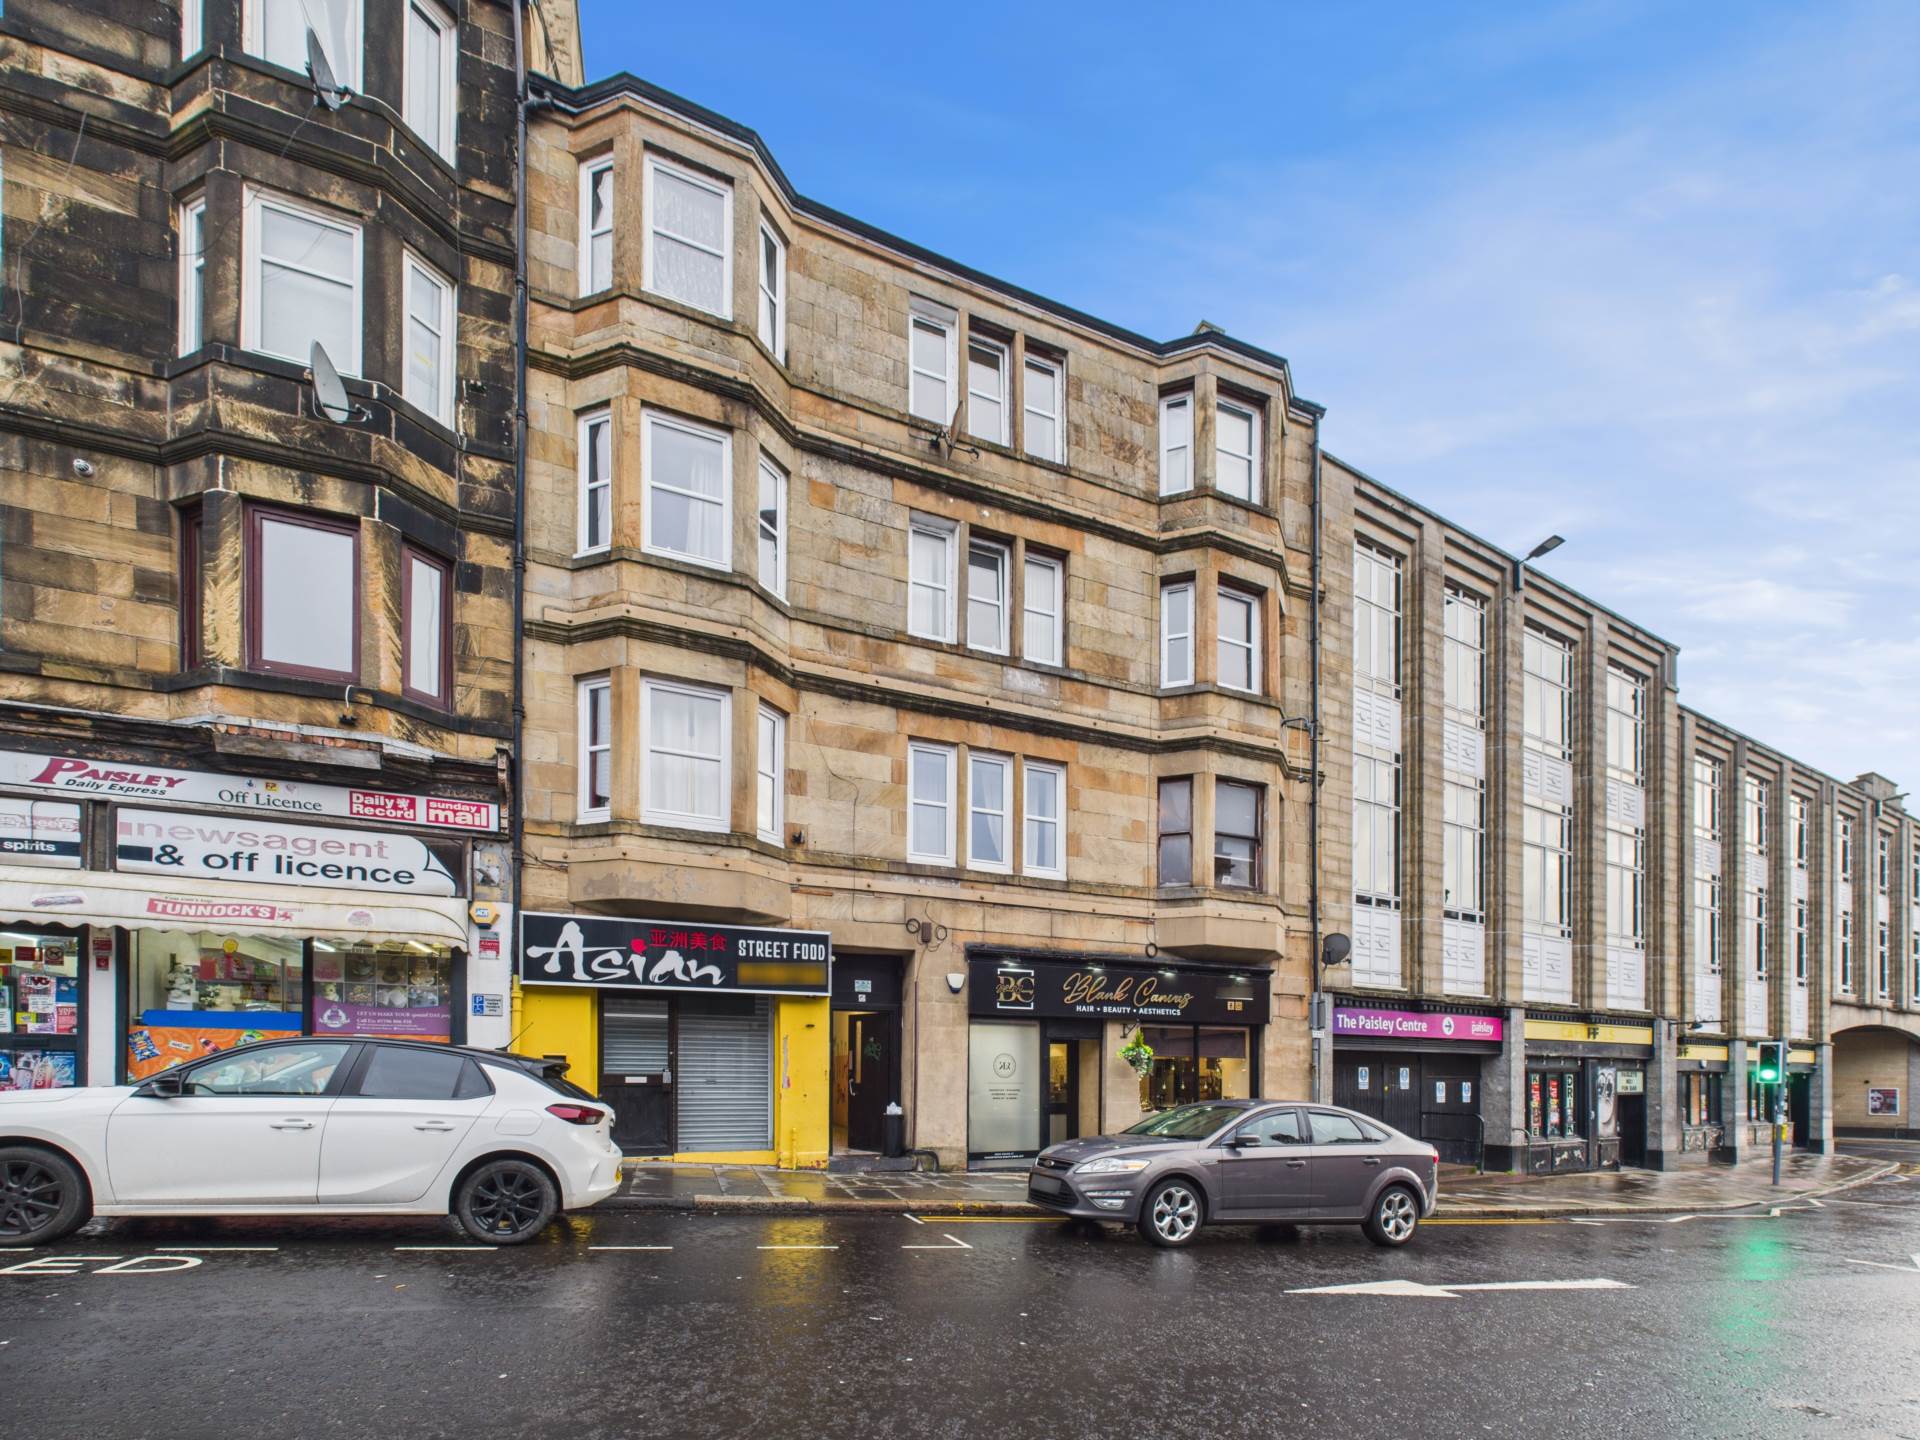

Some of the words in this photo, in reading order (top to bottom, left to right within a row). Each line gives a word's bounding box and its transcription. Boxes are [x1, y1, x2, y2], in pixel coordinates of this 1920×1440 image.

[30, 757, 187, 788] PAISLEY
[65, 779, 104, 791] Daily
[108, 783, 167, 796] Express
[218, 789, 249, 803] Off
[255, 793, 322, 811] Licence
[352, 793, 395, 809] Daily
[429, 801, 477, 813] sunday
[352, 804, 414, 820] Record
[429, 808, 488, 827] mail
[2, 840, 56, 852] spirits
[137, 822, 389, 859] newsagent
[155, 844, 185, 867] &
[202, 851, 259, 871] off
[275, 854, 415, 884] licence
[153, 900, 272, 918] TUNNOCK'S
[649, 928, 727, 951] 亚洲美食
[738, 939, 788, 959] STREET
[793, 942, 826, 961] FOOD
[526, 920, 726, 985] Asian
[1063, 972, 1133, 1003] Blank
[1337, 1014, 1356, 1029] The
[1358, 1015, 1395, 1034] Paisley
[1396, 1017, 1428, 1032] Centre
